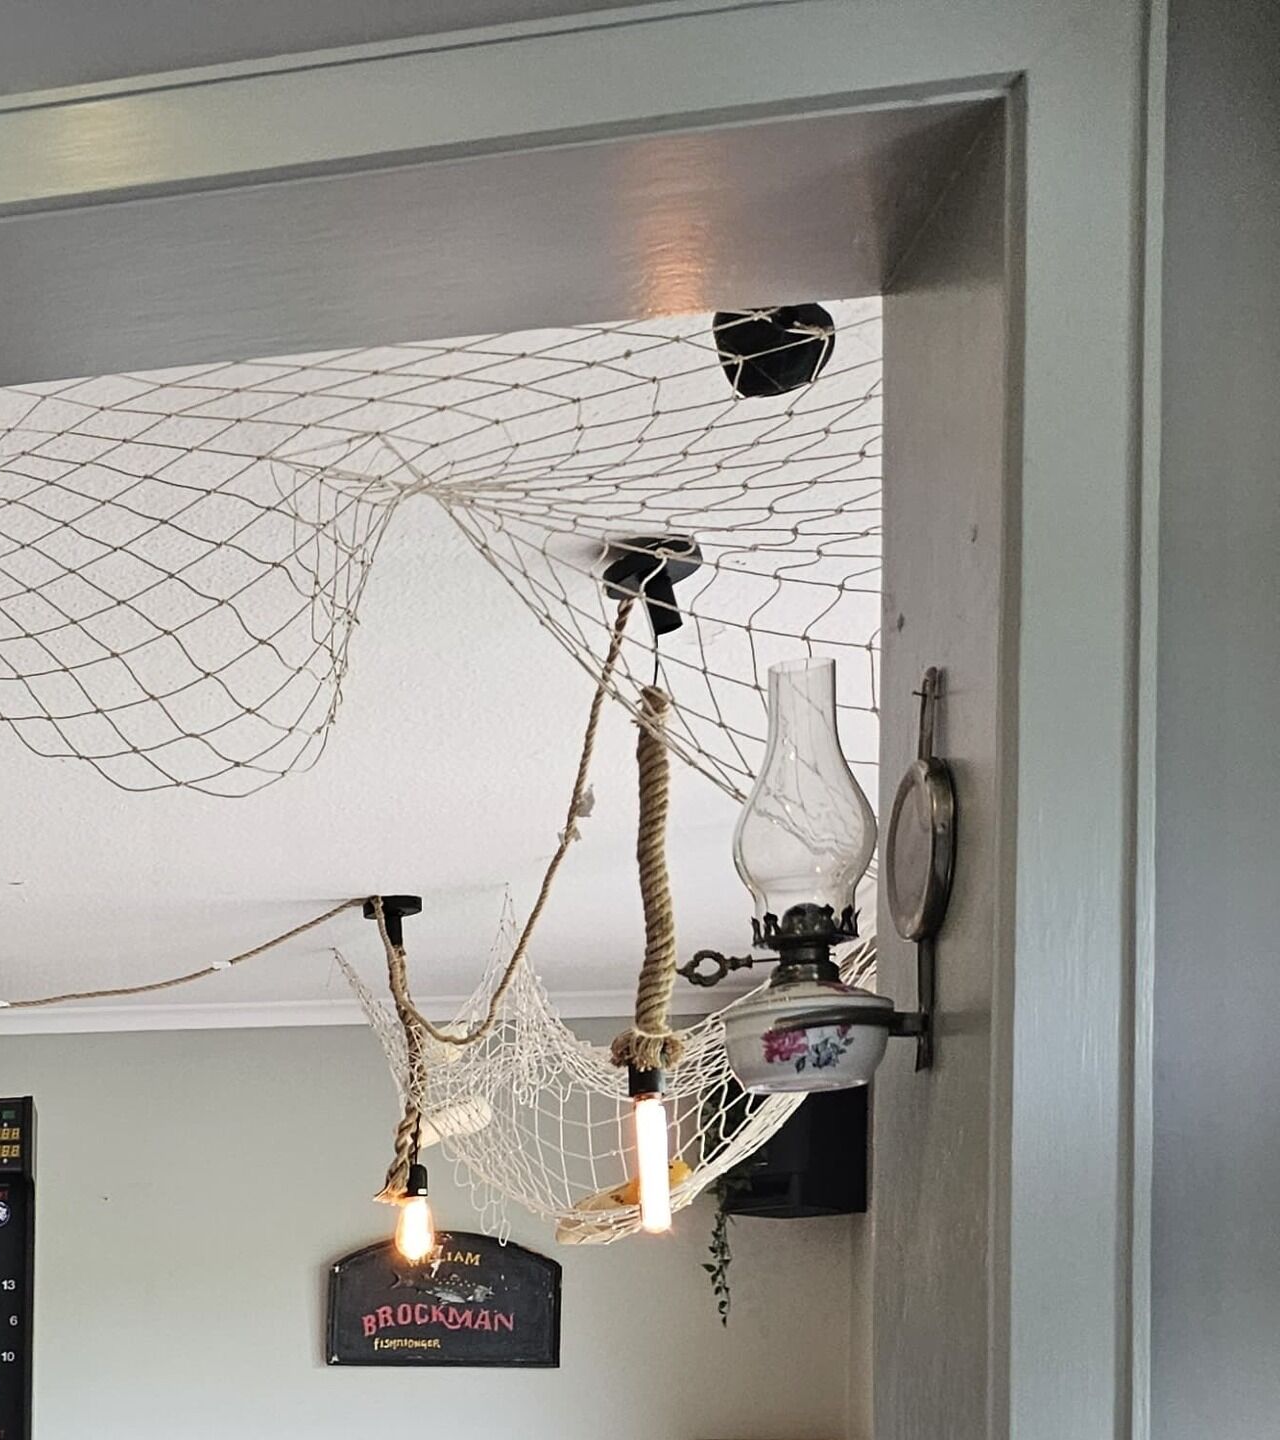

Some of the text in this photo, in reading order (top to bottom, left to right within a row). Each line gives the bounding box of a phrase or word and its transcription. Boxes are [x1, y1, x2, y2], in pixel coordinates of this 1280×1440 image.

[1, 1279, 17, 1290] 13
[9, 1315, 19, 1326] 6
[362, 1303, 515, 1337] BROCKMAN
[1, 1351, 16, 1362] 10
